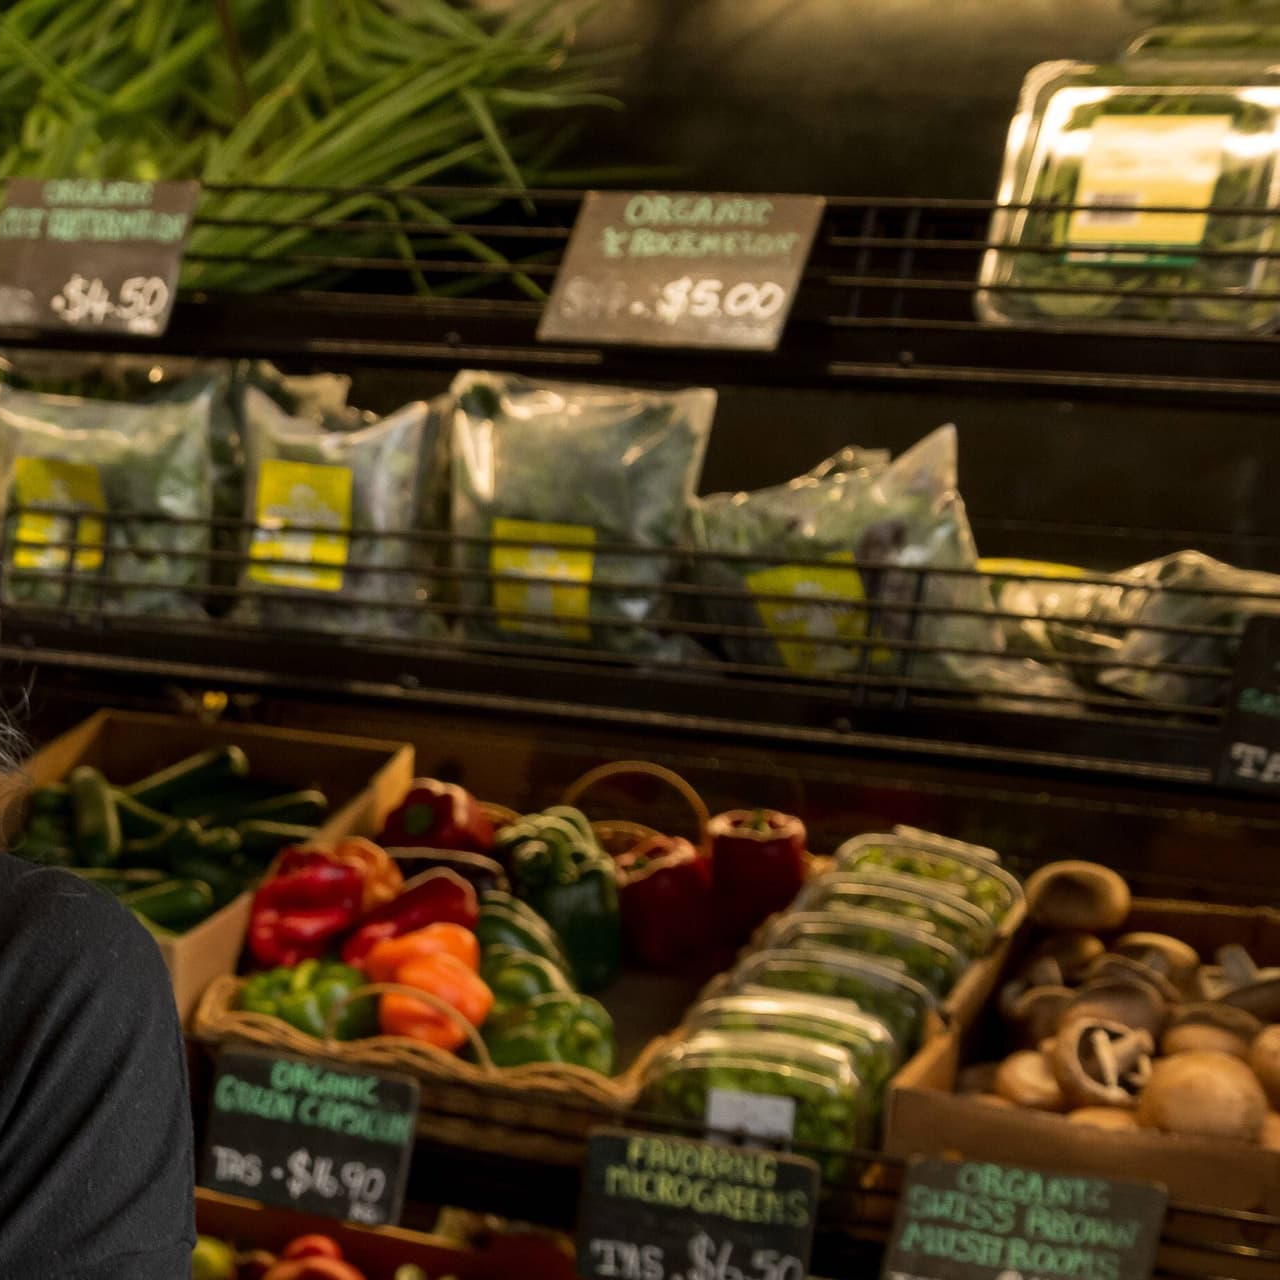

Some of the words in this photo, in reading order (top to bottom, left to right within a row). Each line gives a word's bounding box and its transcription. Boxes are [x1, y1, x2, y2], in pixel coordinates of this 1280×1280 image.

[623, 195, 774, 227] ORGANIC
[656, 276, 786, 325] $5.00
[270, 1059, 381, 1106] ORGANIC
[605, 1165, 810, 1228] MICROGREENS
[905, 1184, 1017, 1235] SWISS
